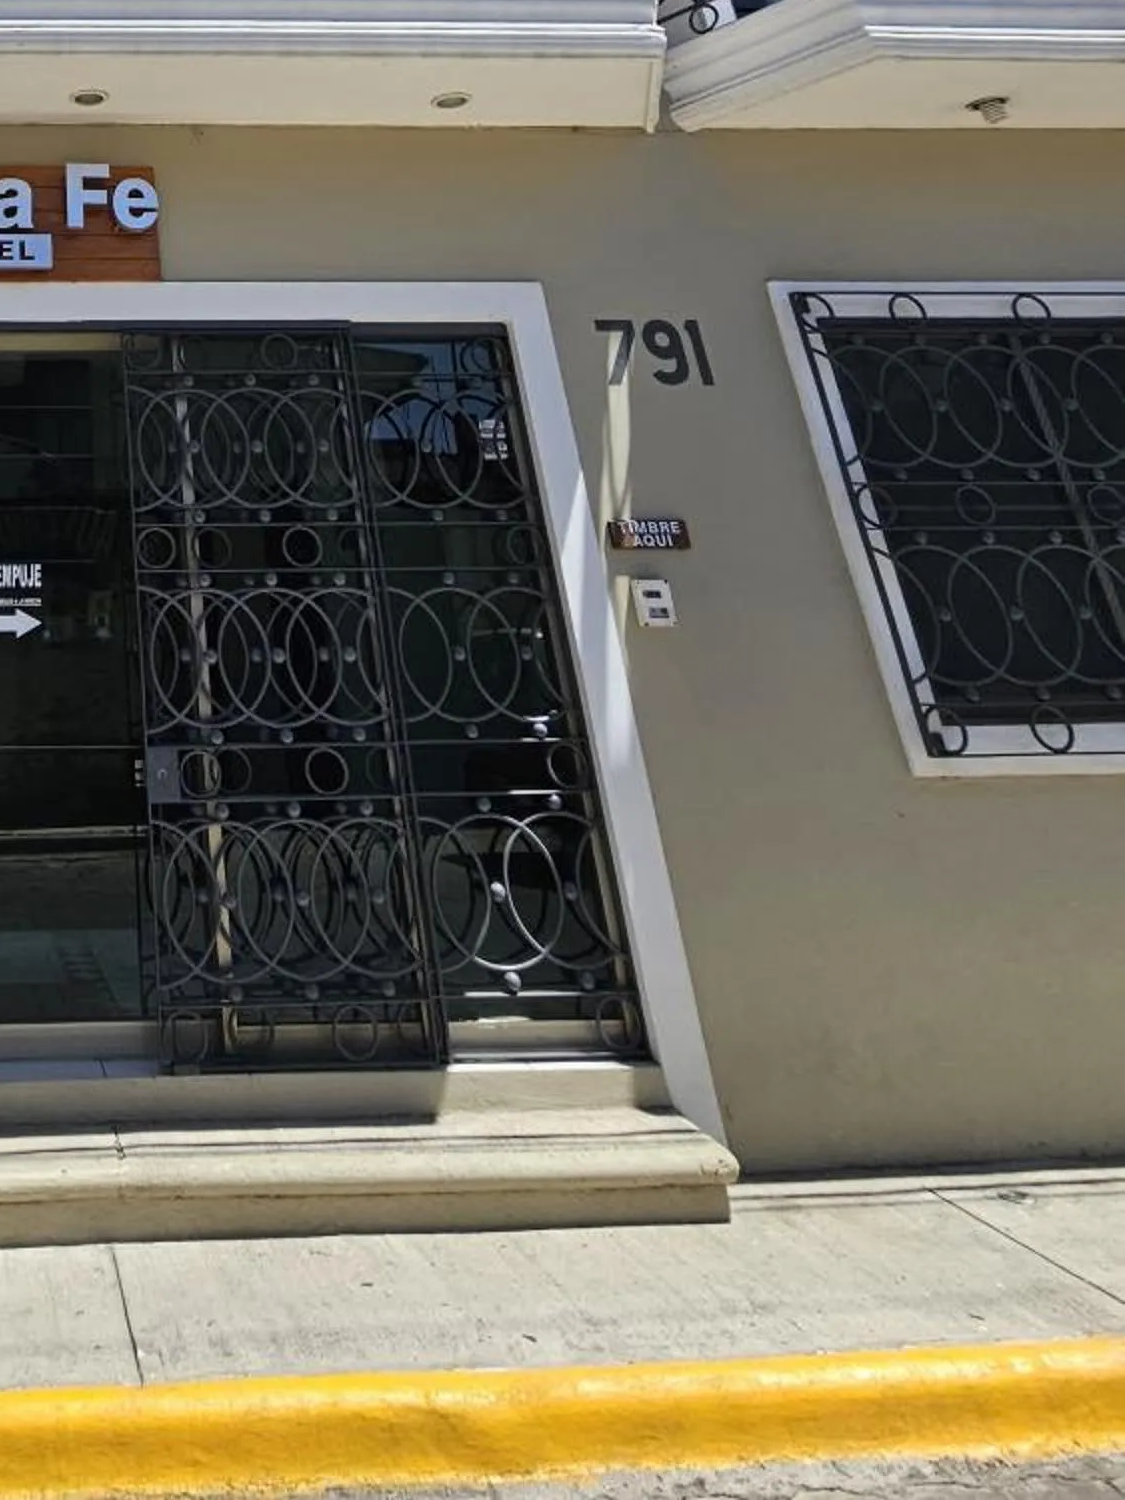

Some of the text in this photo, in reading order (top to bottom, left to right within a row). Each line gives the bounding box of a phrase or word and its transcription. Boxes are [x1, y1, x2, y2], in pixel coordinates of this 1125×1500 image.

[65, 163, 160, 233] Fe
[594, 318, 715, 387] 791
[617, 519, 681, 534] TIMBRE
[633, 533, 674, 548] AQUI
